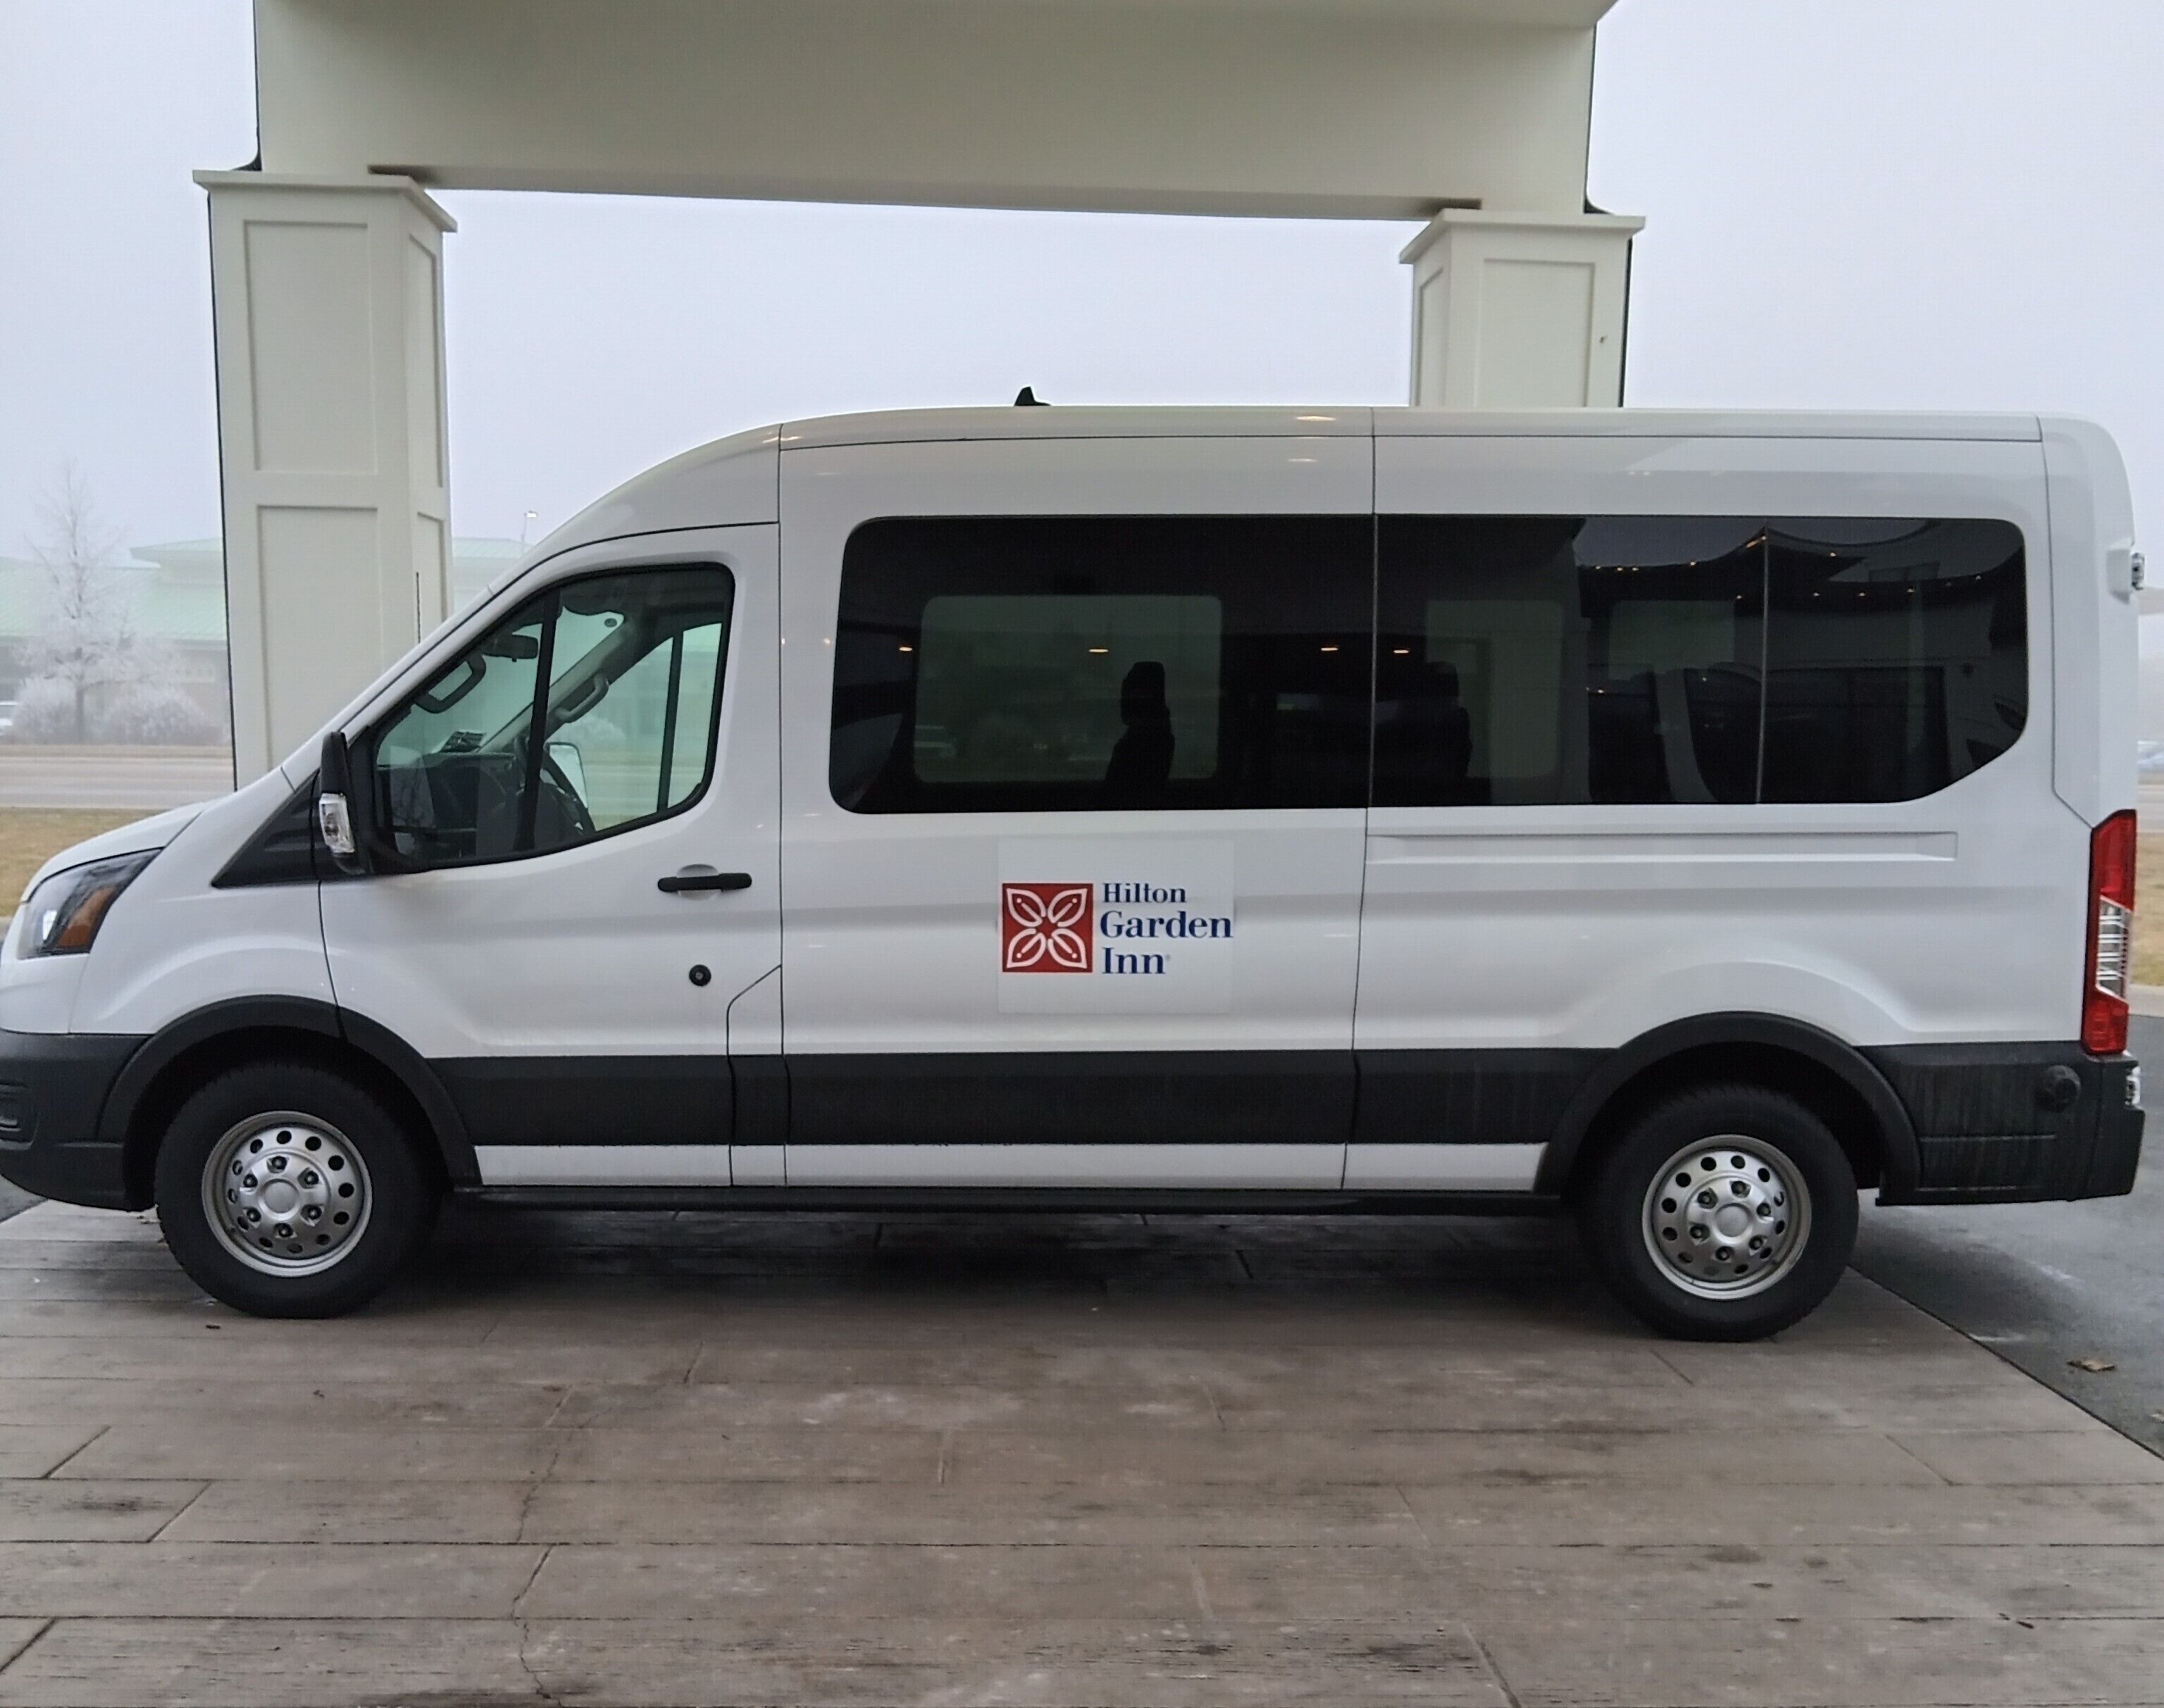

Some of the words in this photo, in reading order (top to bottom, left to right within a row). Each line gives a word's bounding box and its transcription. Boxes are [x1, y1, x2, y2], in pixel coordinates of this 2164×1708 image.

[1102, 883, 1187, 904] Hilton
[1100, 910, 1234, 938] Garden
[1102, 947, 1166, 975] Inn
